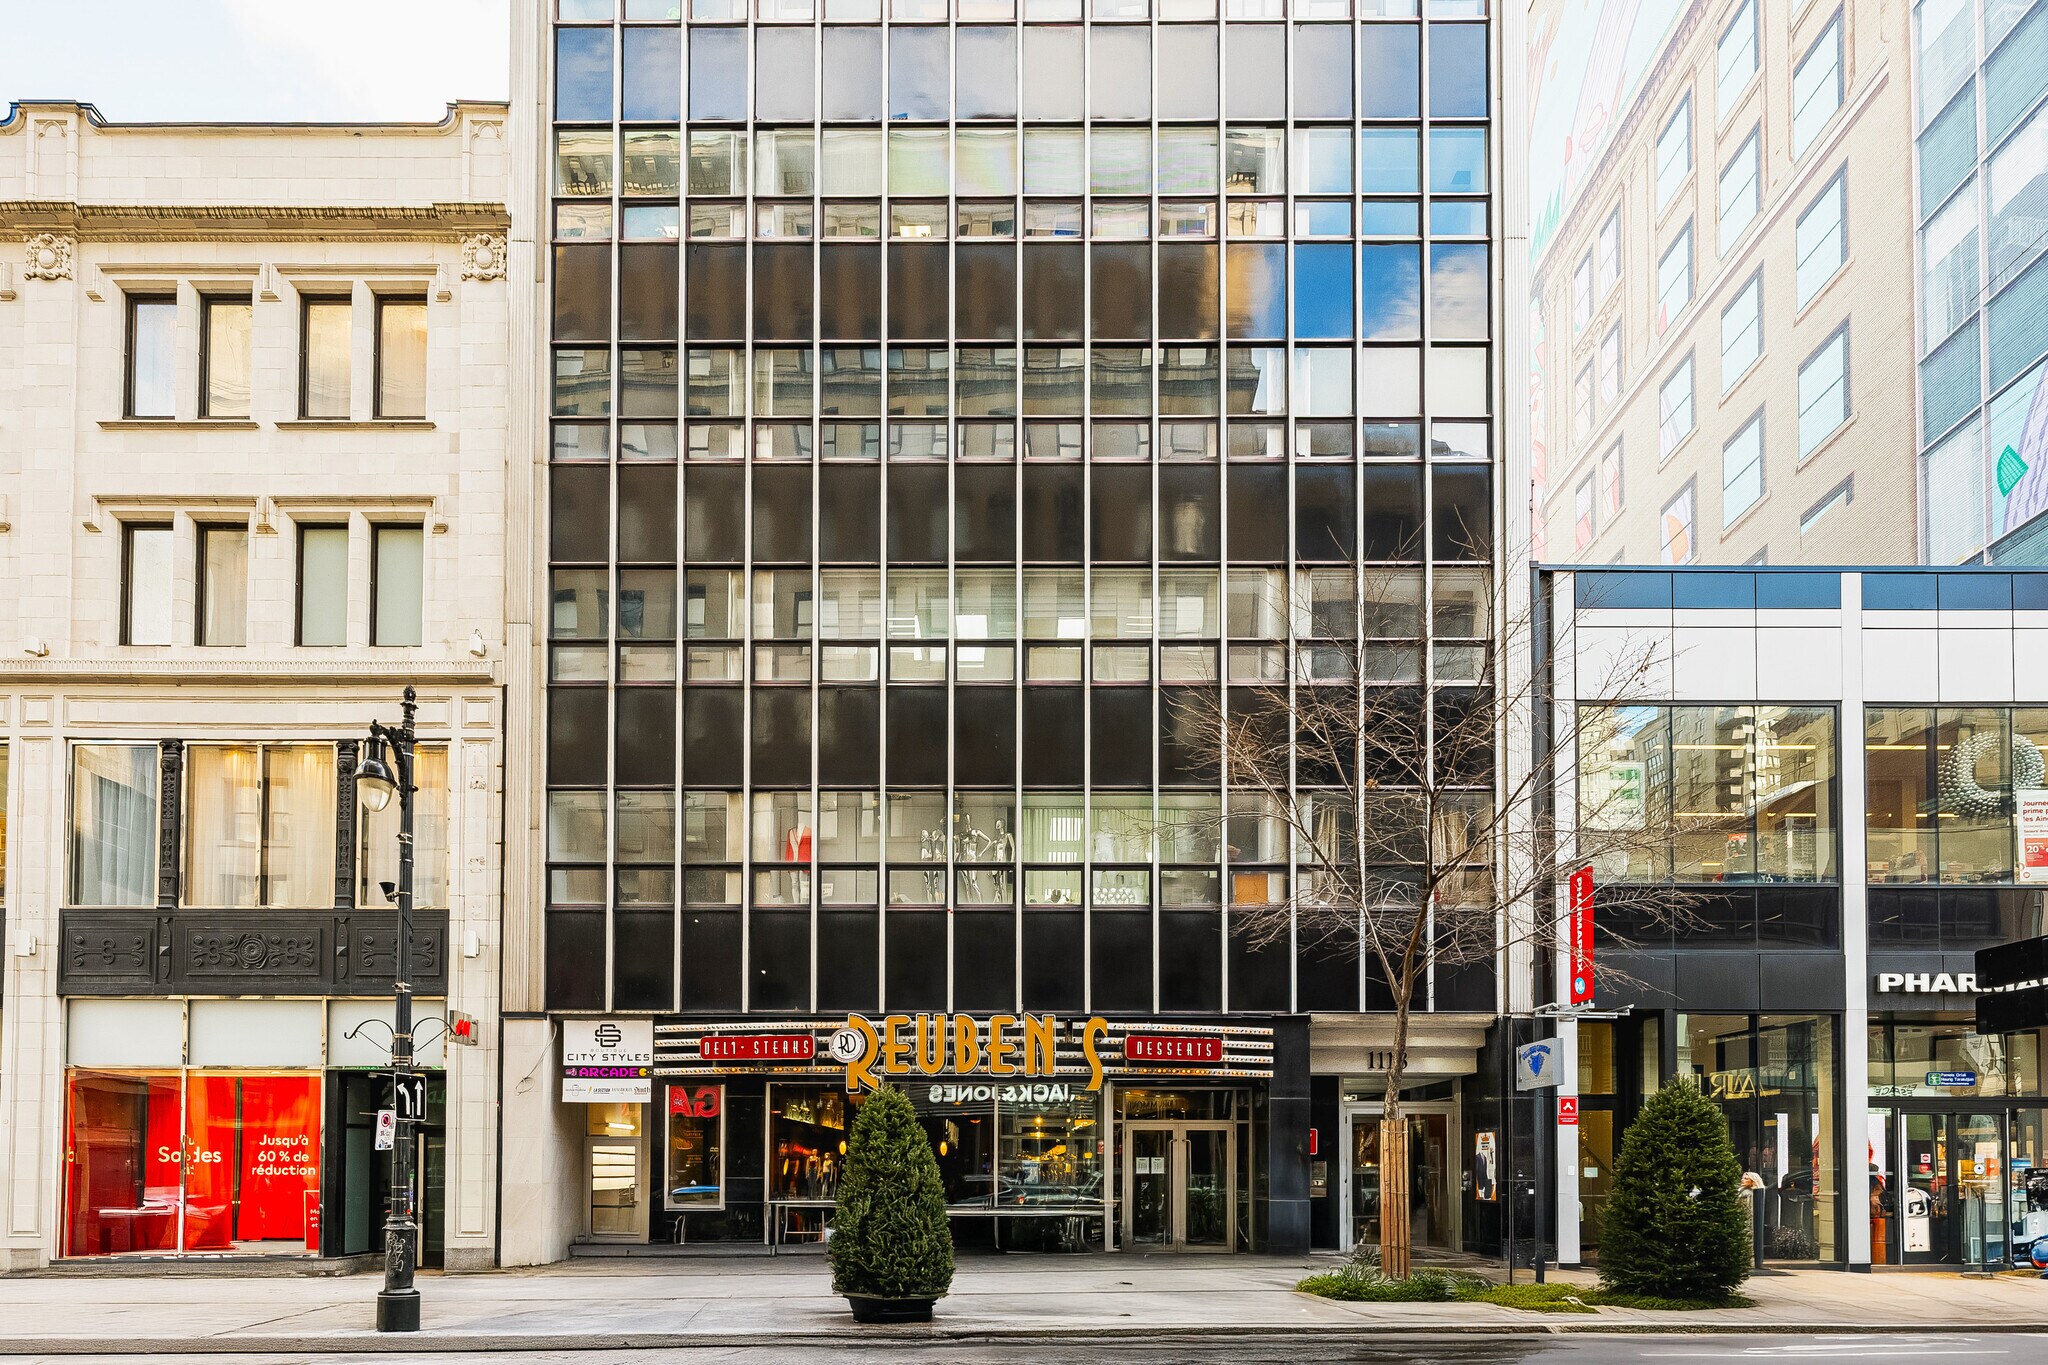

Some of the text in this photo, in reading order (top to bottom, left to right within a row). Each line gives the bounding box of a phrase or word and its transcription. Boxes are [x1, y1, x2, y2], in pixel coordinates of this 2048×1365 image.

[753, 1039, 810, 1055] STEAKS
[1136, 1041, 1213, 1057] DESSERTS
[567, 1053, 650, 1062] CITY STYLES
[579, 1067, 639, 1078] ARCADE
[259, 1134, 309, 1148] Jusqu'à
[158, 1146, 222, 1163] Sodes
[258, 1150, 310, 1162] 60 % de
[251, 1164, 316, 1176] réduction
